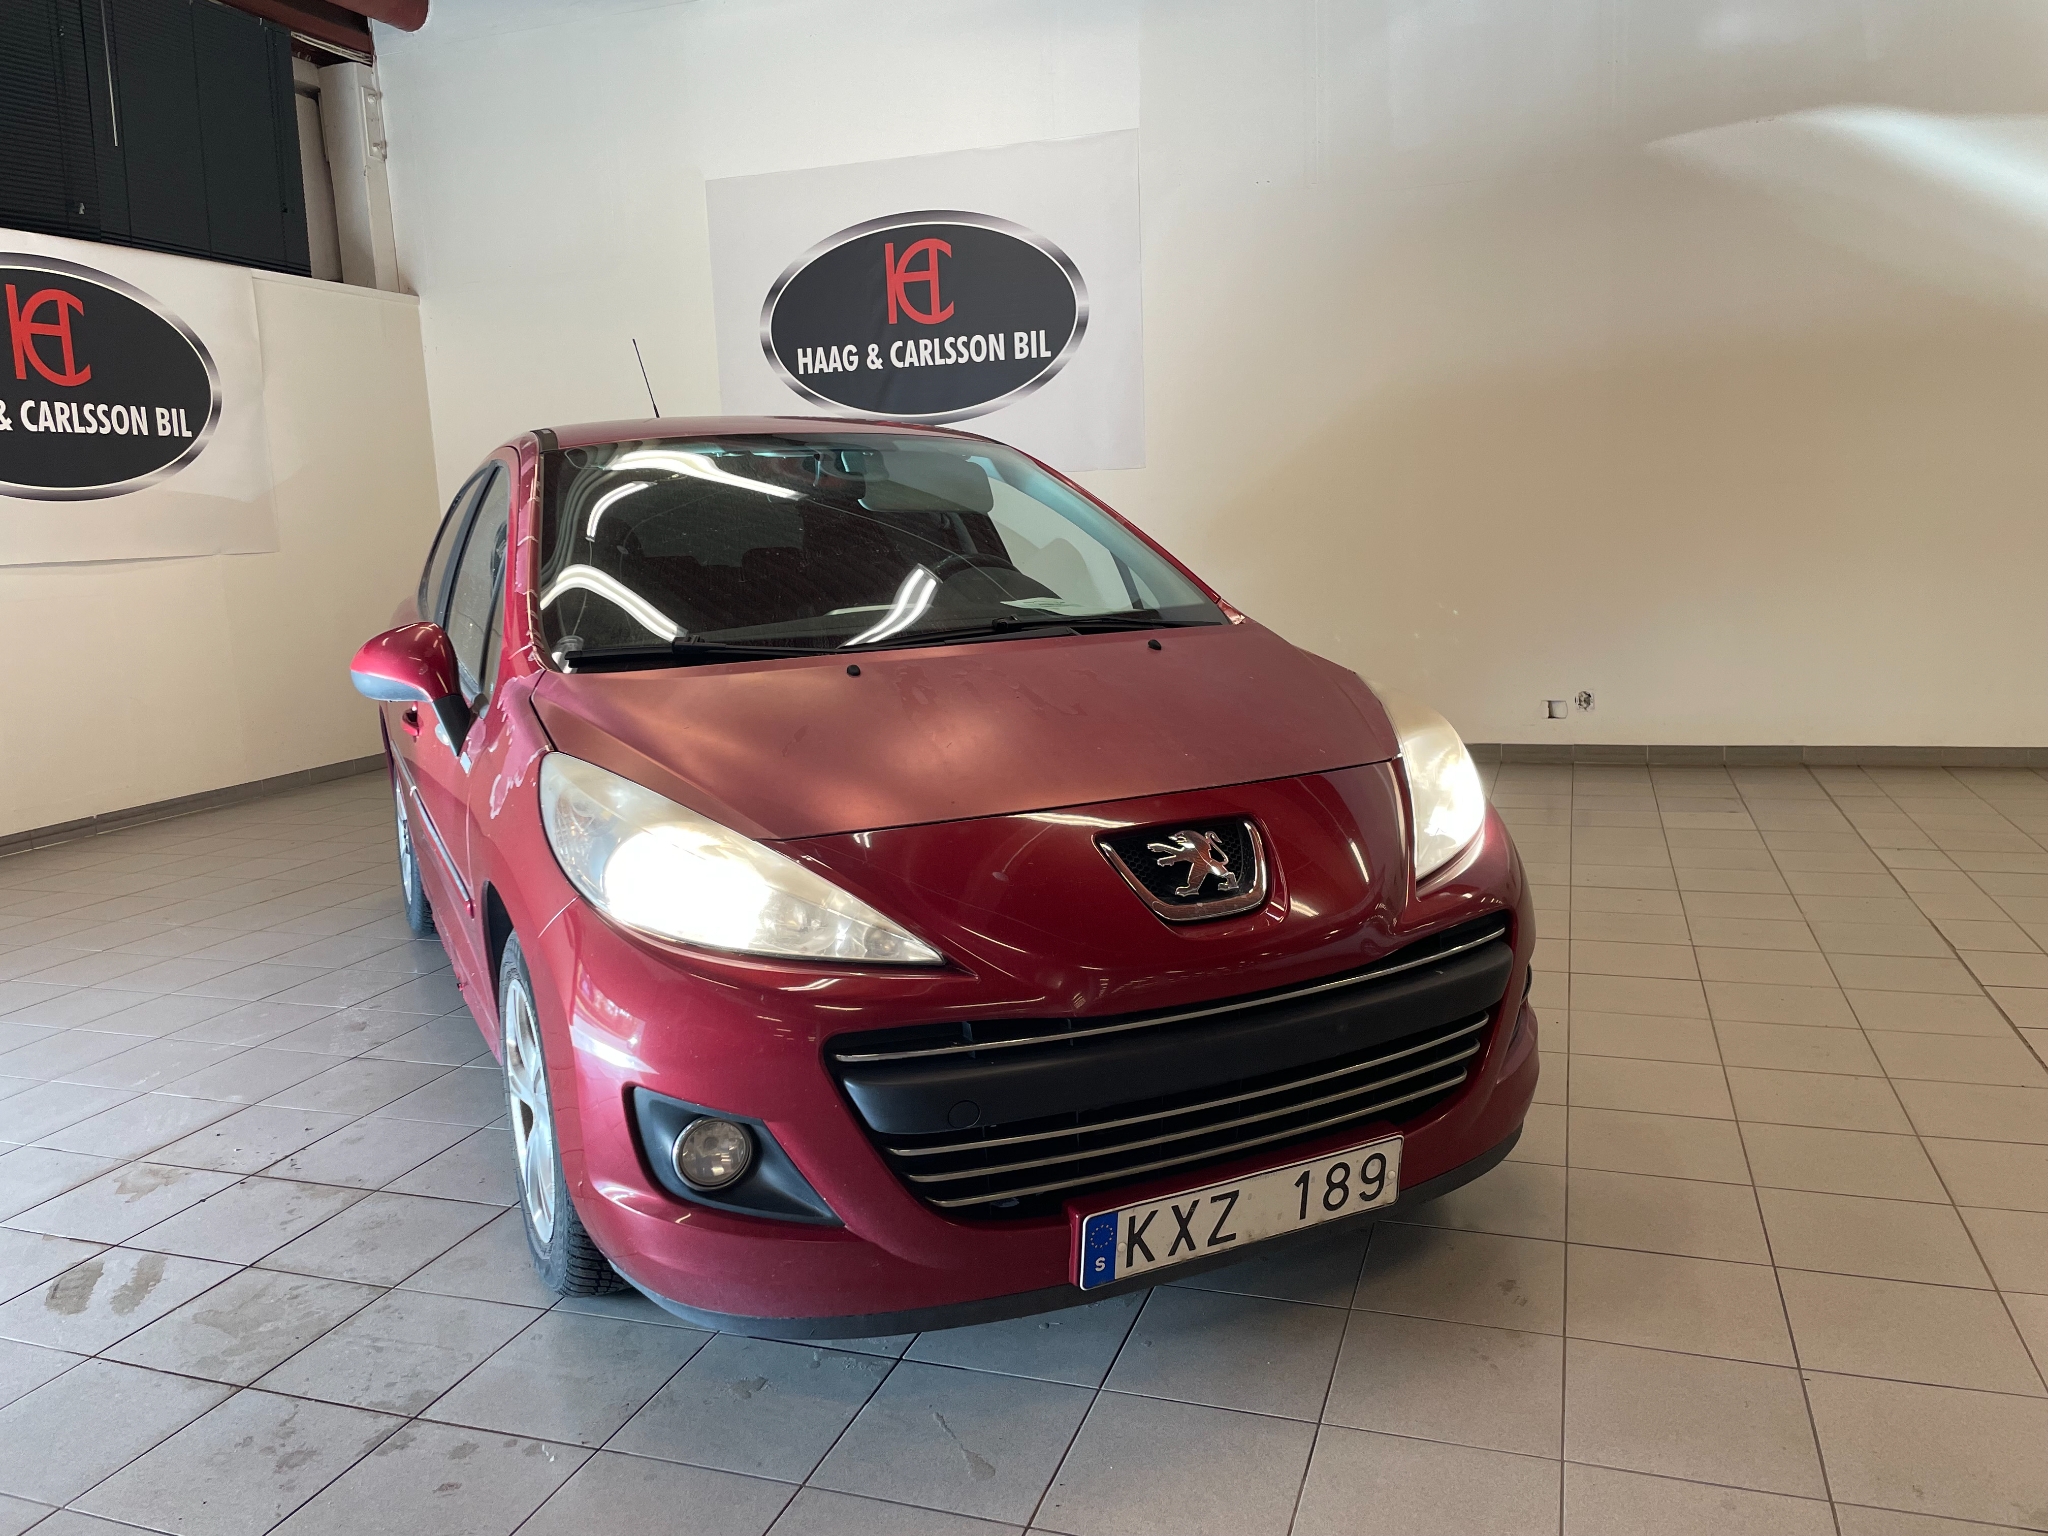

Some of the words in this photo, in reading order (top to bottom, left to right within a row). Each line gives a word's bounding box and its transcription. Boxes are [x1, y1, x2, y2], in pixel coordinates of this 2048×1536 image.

[797, 344, 859, 374] HAAG
[866, 343, 883, 370] &
[890, 333, 1005, 368] CARLSSON
[1013, 330, 1051, 360] BIL
[0, 399, 13, 432] &
[20, 400, 148, 436] CARLSSON
[156, 408, 192, 438] BIL
[1125, 1190, 1240, 1268] KXZ
[1293, 1152, 1387, 1221] 189
[1095, 1256, 1106, 1272] S
